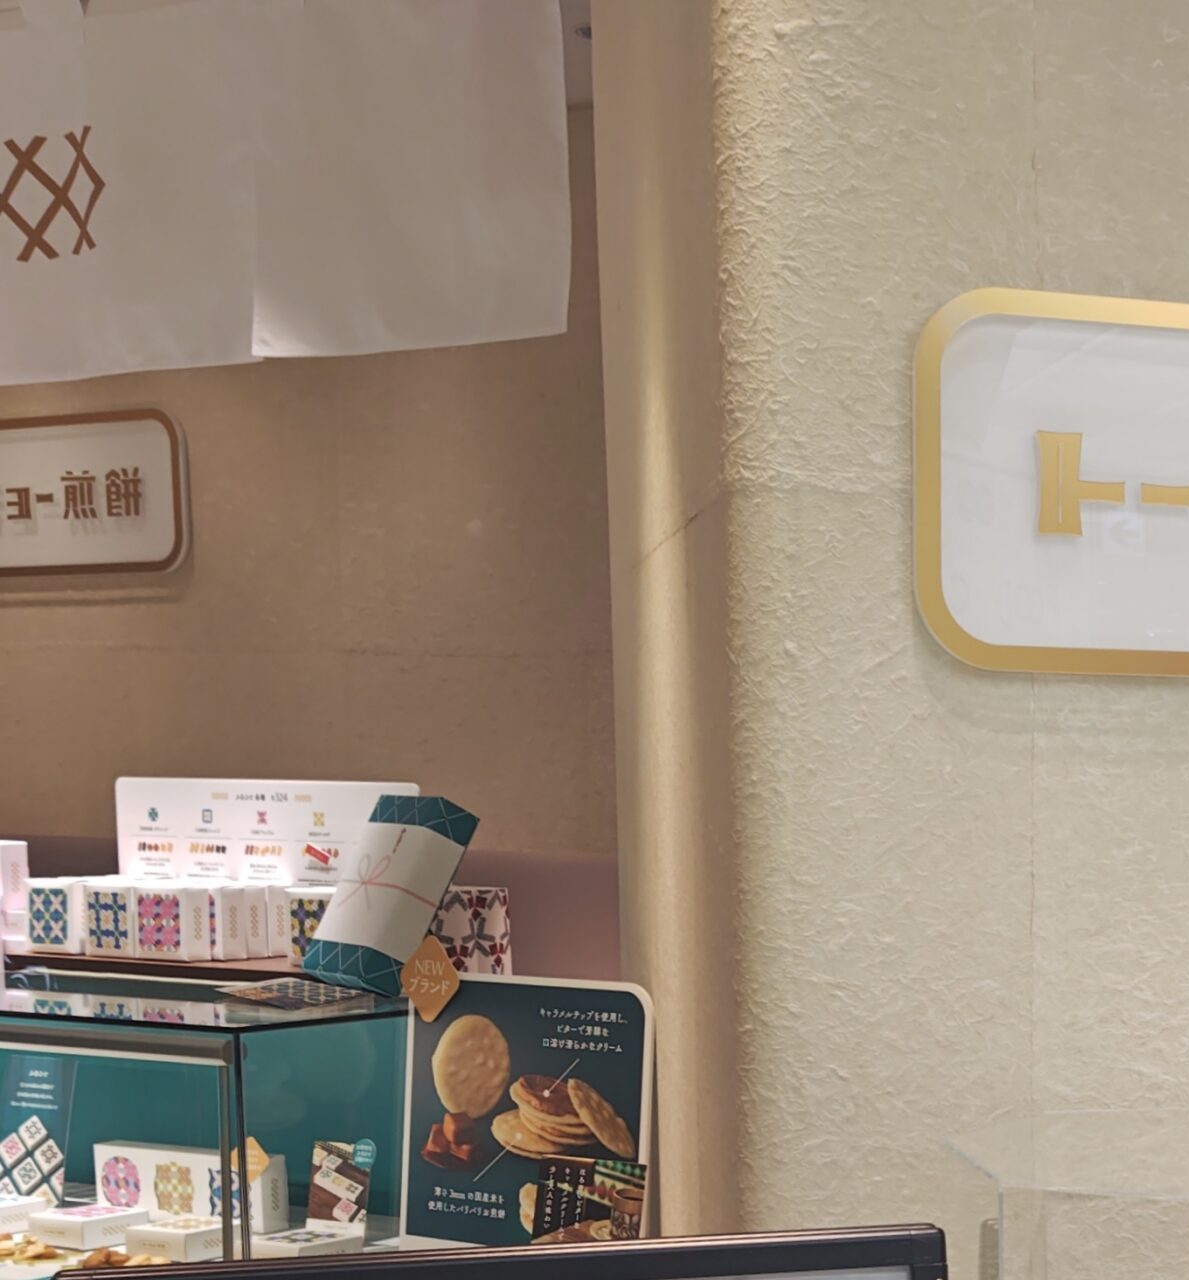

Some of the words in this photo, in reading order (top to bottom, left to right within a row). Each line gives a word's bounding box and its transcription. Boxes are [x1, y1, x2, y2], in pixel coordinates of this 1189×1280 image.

[414, 959, 445, 976] NEW
[408, 976, 451, 996] ブランド
